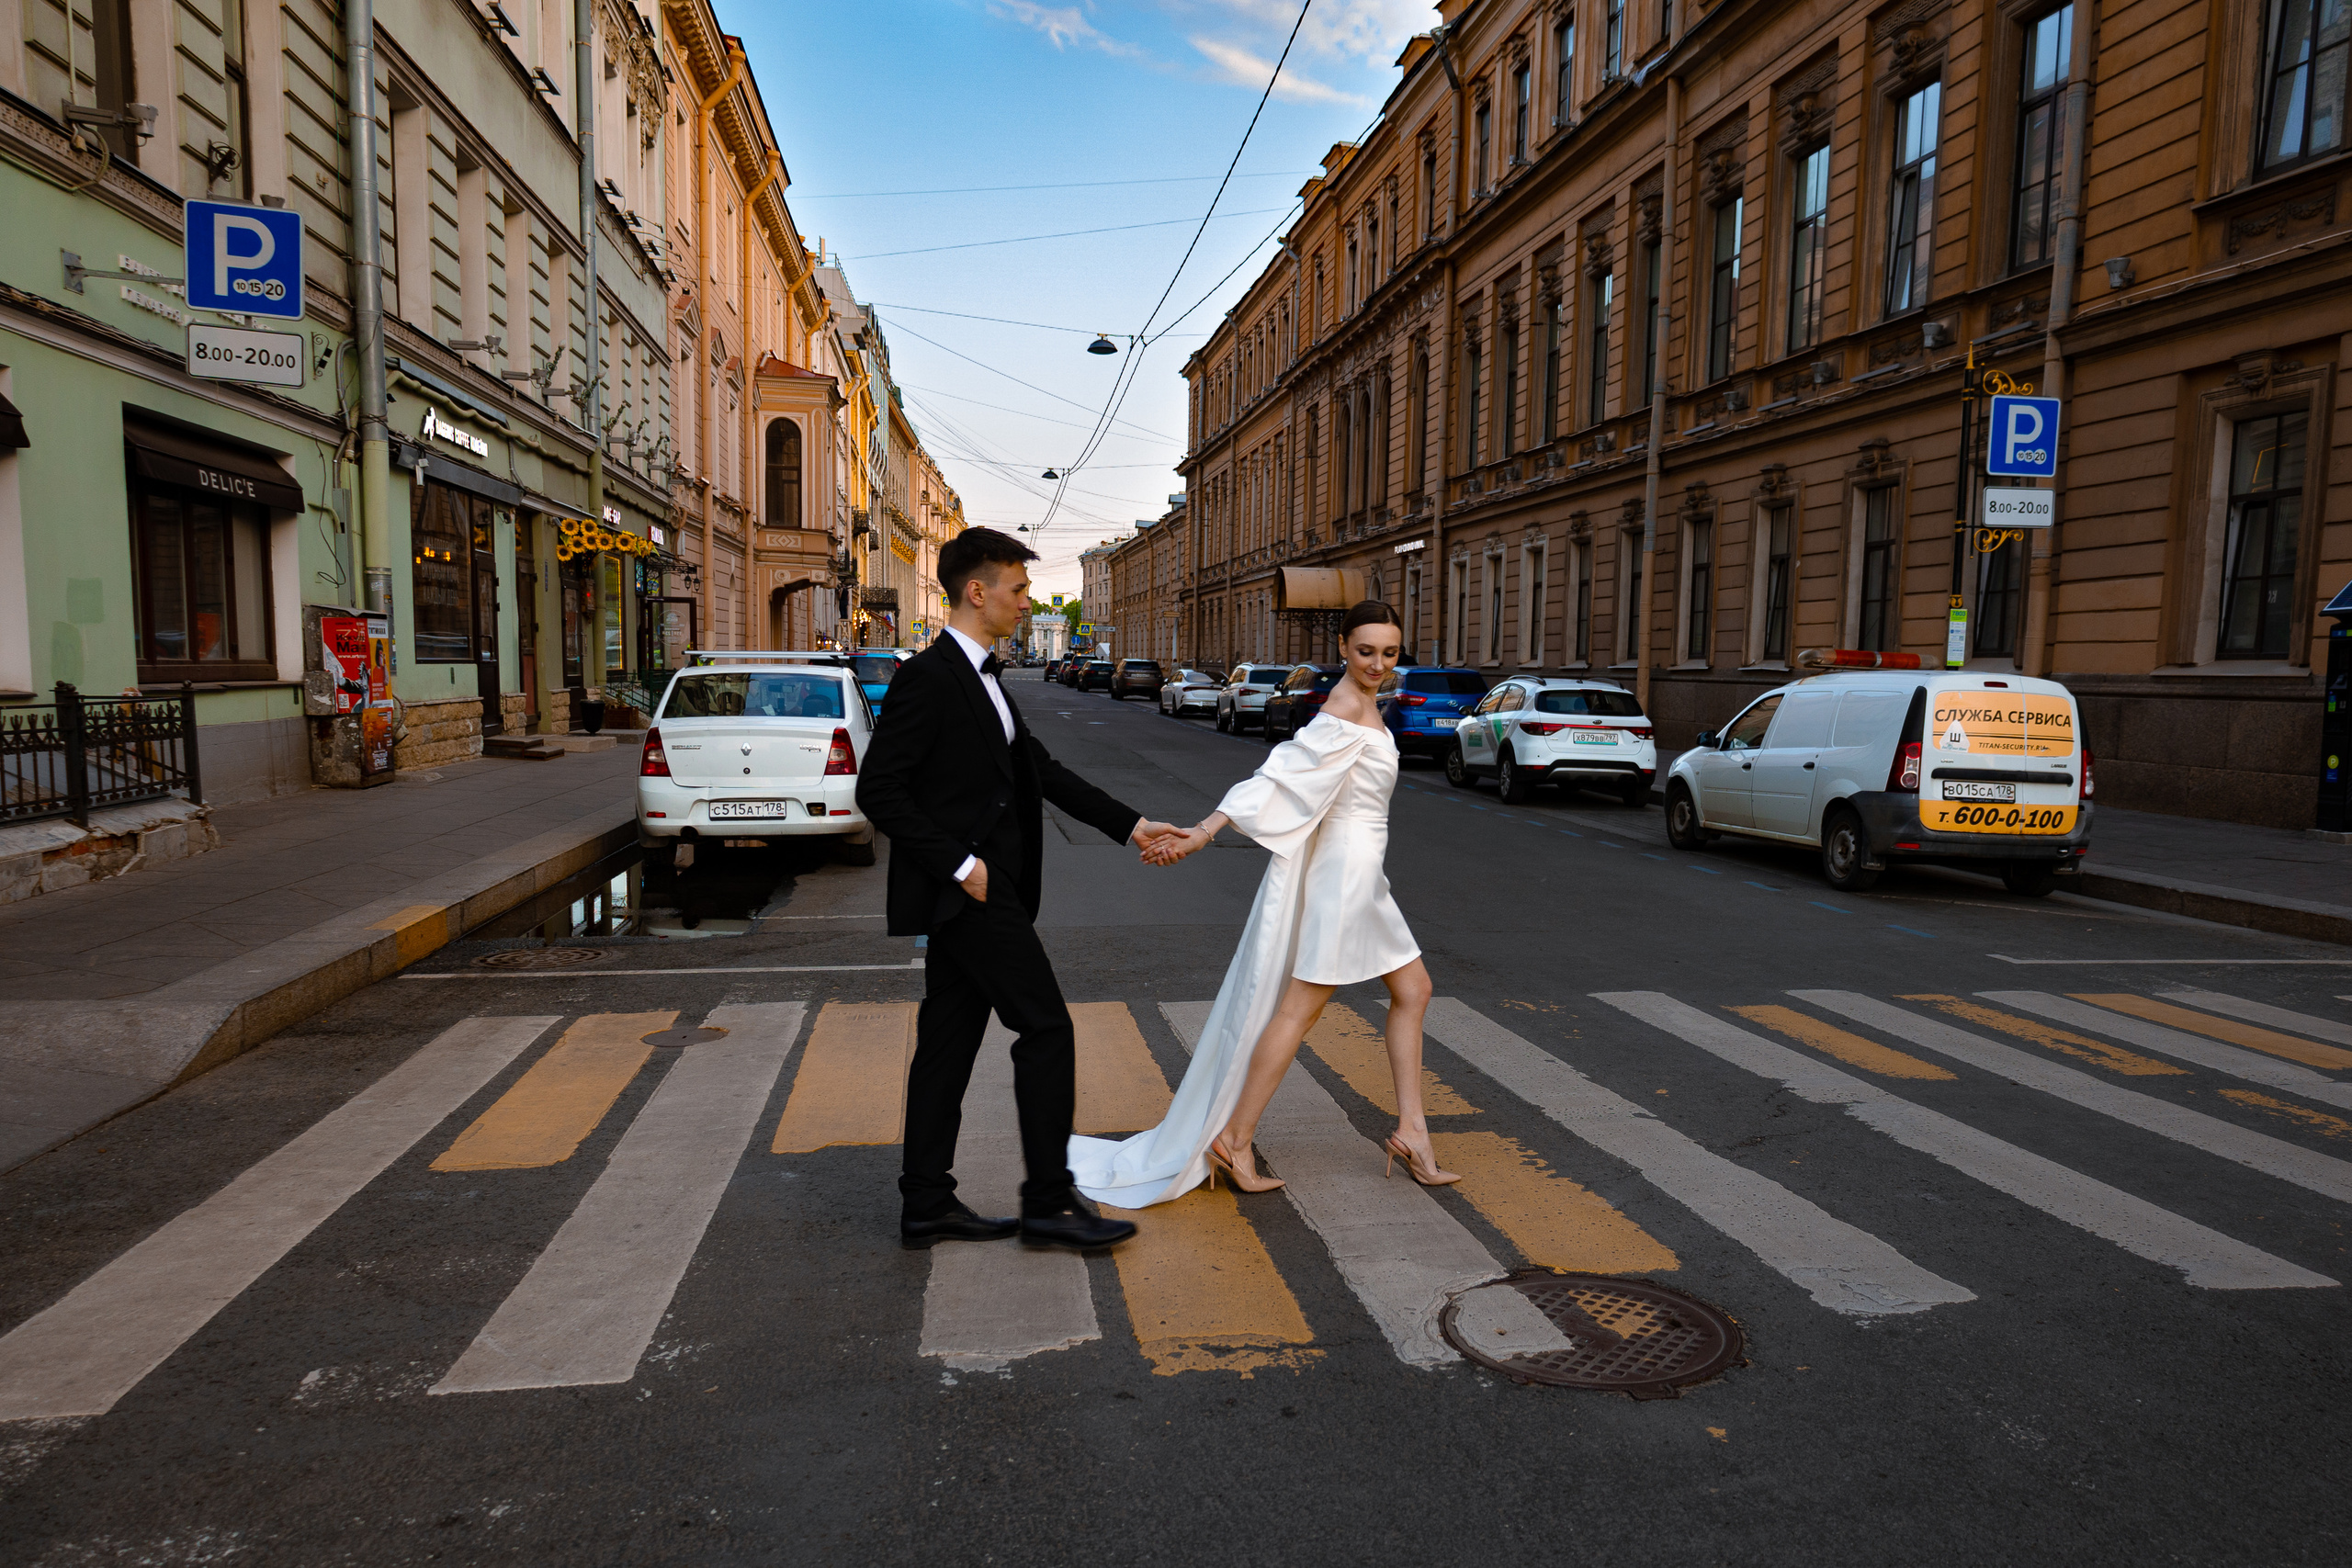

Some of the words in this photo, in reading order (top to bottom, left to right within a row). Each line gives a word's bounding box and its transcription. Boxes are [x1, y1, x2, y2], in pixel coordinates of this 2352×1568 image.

[214, 212, 276, 297] P
[249, 282, 262, 293] 15
[265, 283, 284, 297] 20
[195, 342, 296, 369] 8.00-20.00
[2005, 404, 2043, 464] P
[2034, 452, 2046, 461] 20
[198, 469, 256, 498] DELIC'E
[1989, 501, 2049, 514] 8.00-20.00
[1935, 709, 2003, 723] СЛУЖБА
[2008, 711, 2072, 728] СЕРВИСА
[1950, 732, 1962, 743] Ш
[1948, 784, 1994, 796] В015СА
[1996, 785, 2012, 795] 178
[713, 804, 762, 816] С515АТ
[763, 803, 782, 812] 178
[1954, 807, 2064, 829] 600-0-100
